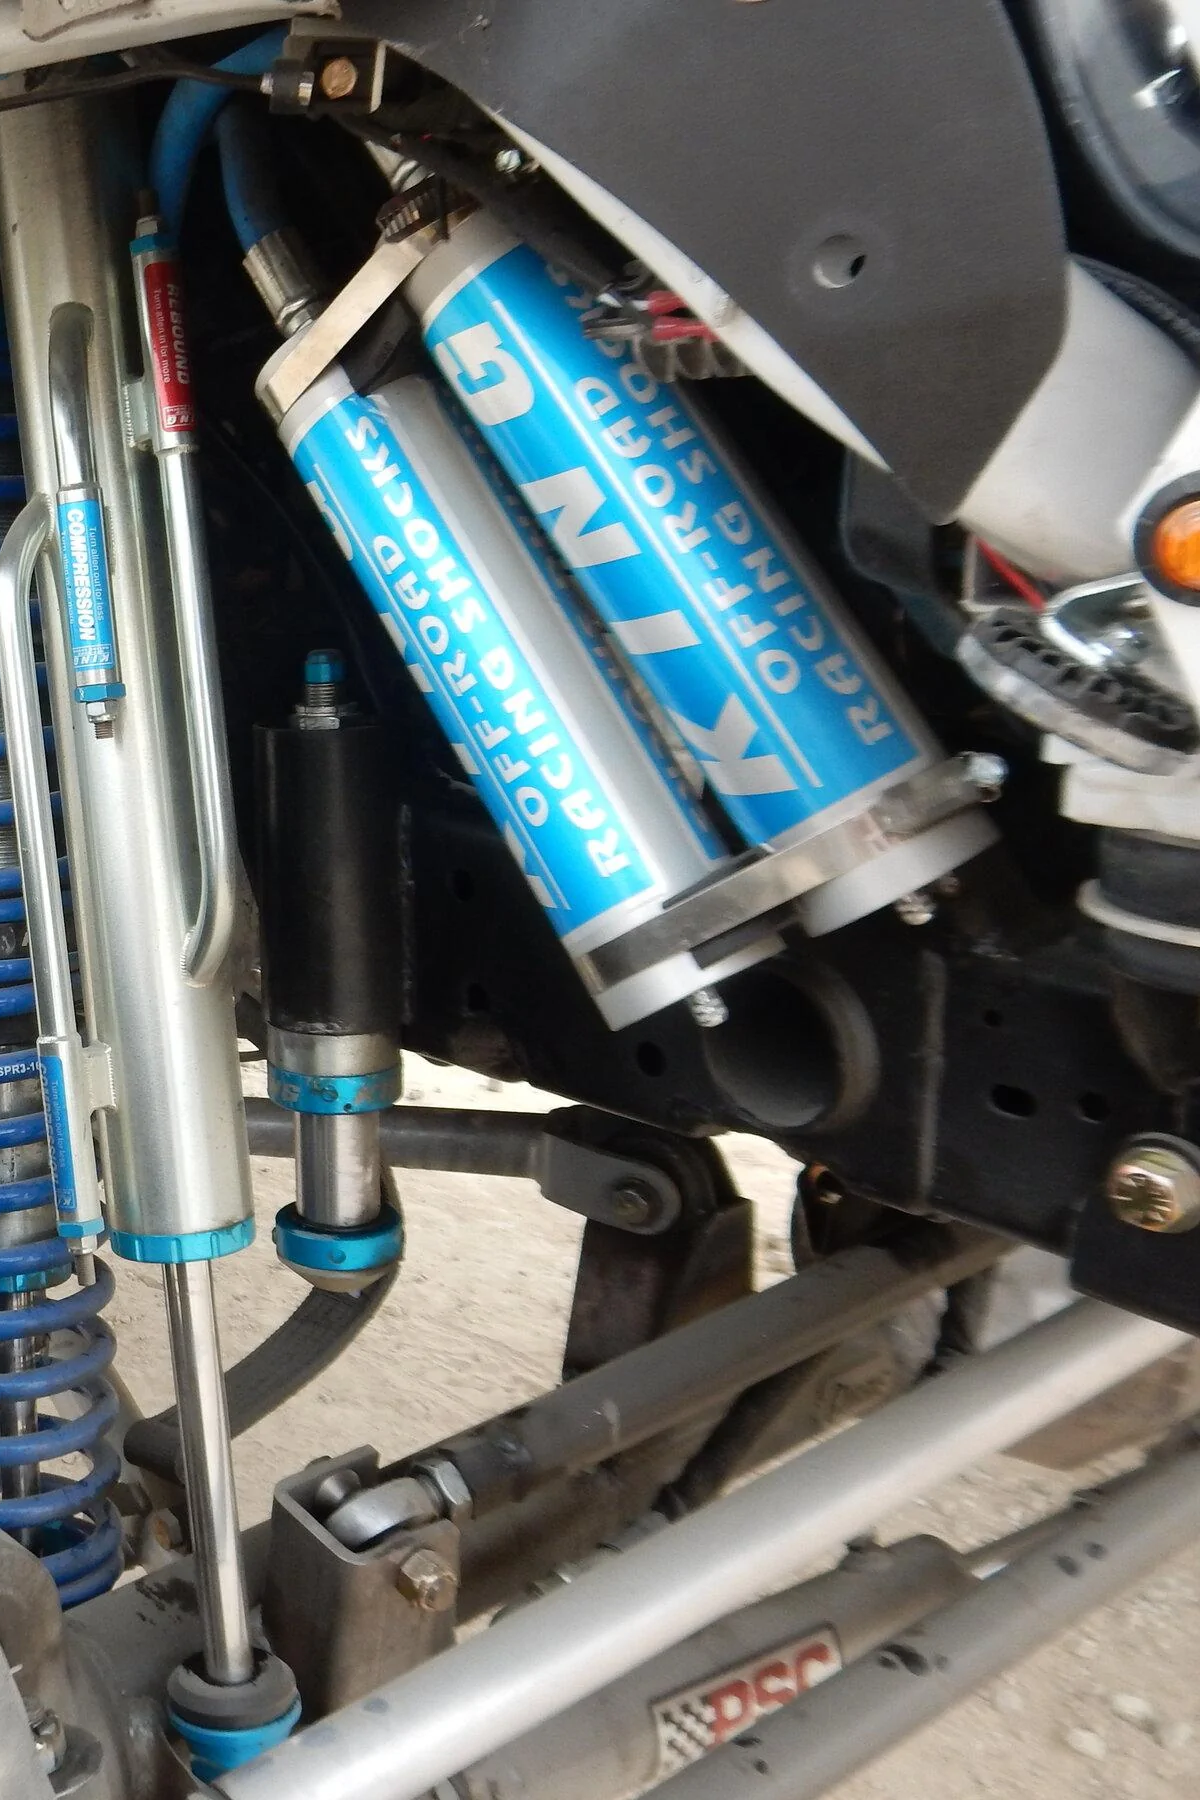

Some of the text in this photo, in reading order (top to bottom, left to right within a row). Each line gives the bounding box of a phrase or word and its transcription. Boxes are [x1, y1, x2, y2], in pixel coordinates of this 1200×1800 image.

[153, 288, 172, 383] Turn allen in for more
[167, 283, 191, 385] REBOUND
[67, 508, 96, 641] COMPRESSION
[91, 549, 100, 571] allen
[93, 572, 101, 587] out
[345, 415, 487, 635] SHOCKS
[436, 321, 798, 796] KING
[574, 376, 798, 695] OFF-ROAD
[95, 588, 103, 602] for
[96, 603, 104, 621] less
[718, 501, 892, 746] RACING
[373, 535, 549, 828] OFF-ROAD
[481, 648, 631, 878] RACING
